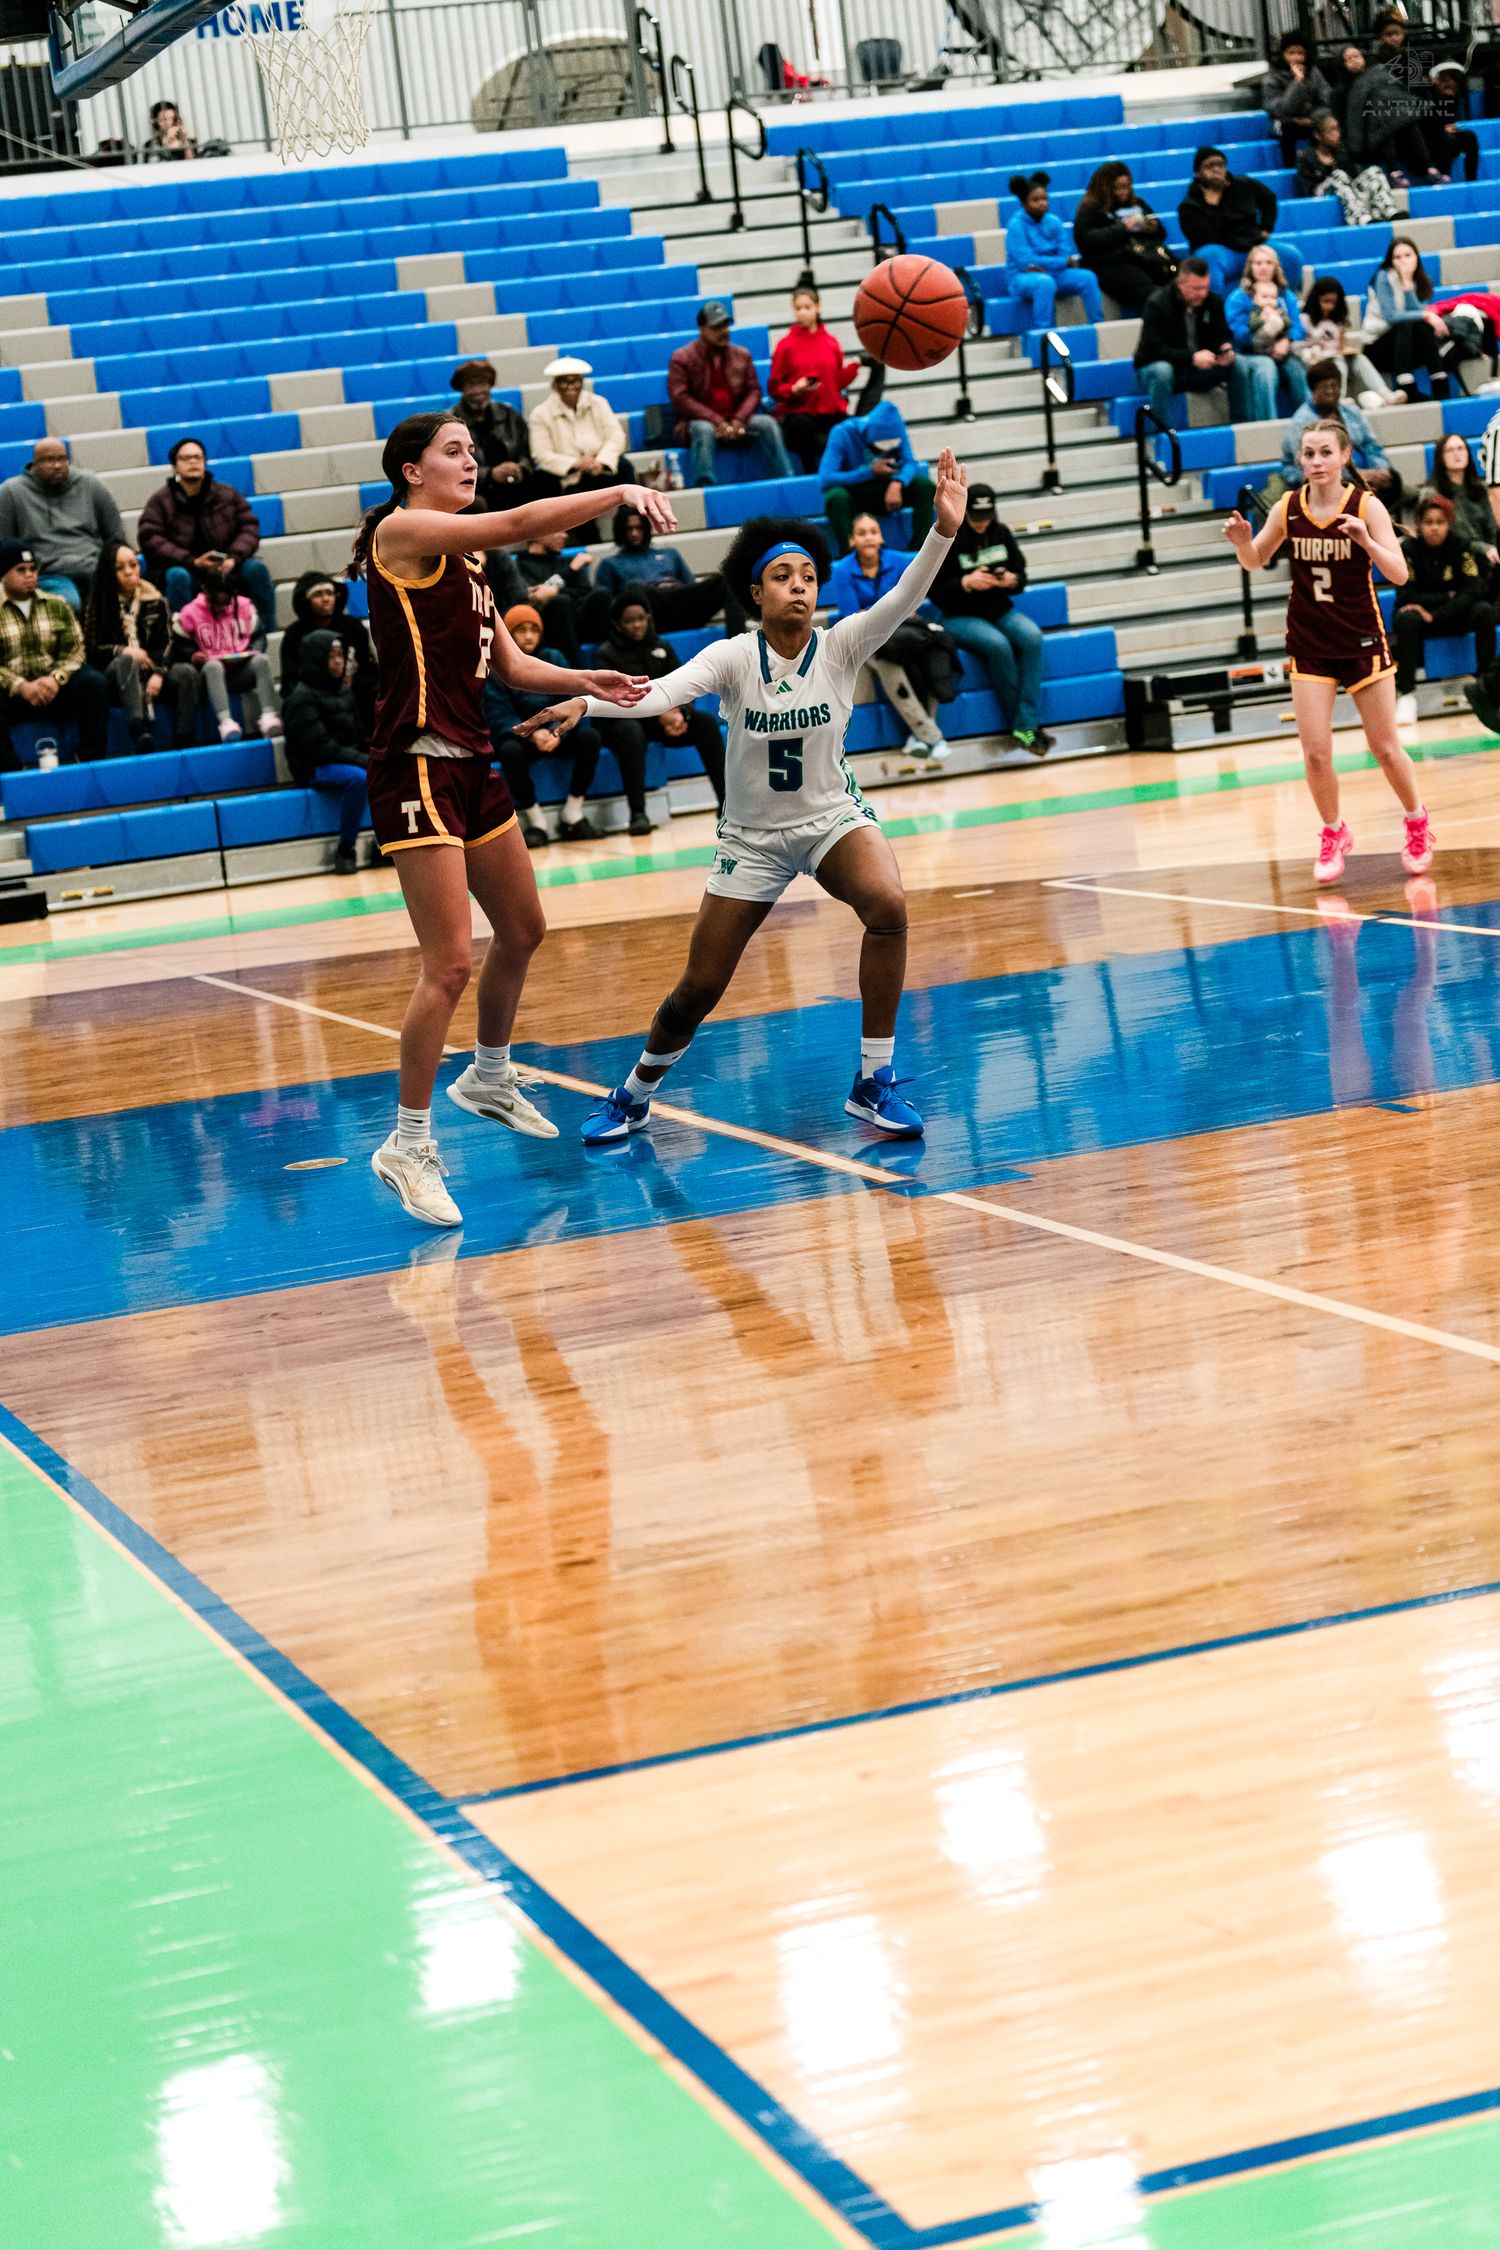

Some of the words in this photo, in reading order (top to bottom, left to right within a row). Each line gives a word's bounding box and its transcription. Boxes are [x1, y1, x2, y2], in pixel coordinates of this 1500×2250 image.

[196, 0, 305, 39] HOME
[1292, 537, 1352, 562] TURPIN
[1311, 567, 1334, 603] 2
[745, 703, 831, 733] WARRIORS
[768, 737, 804, 792] 5
[401, 800, 421, 834] T
